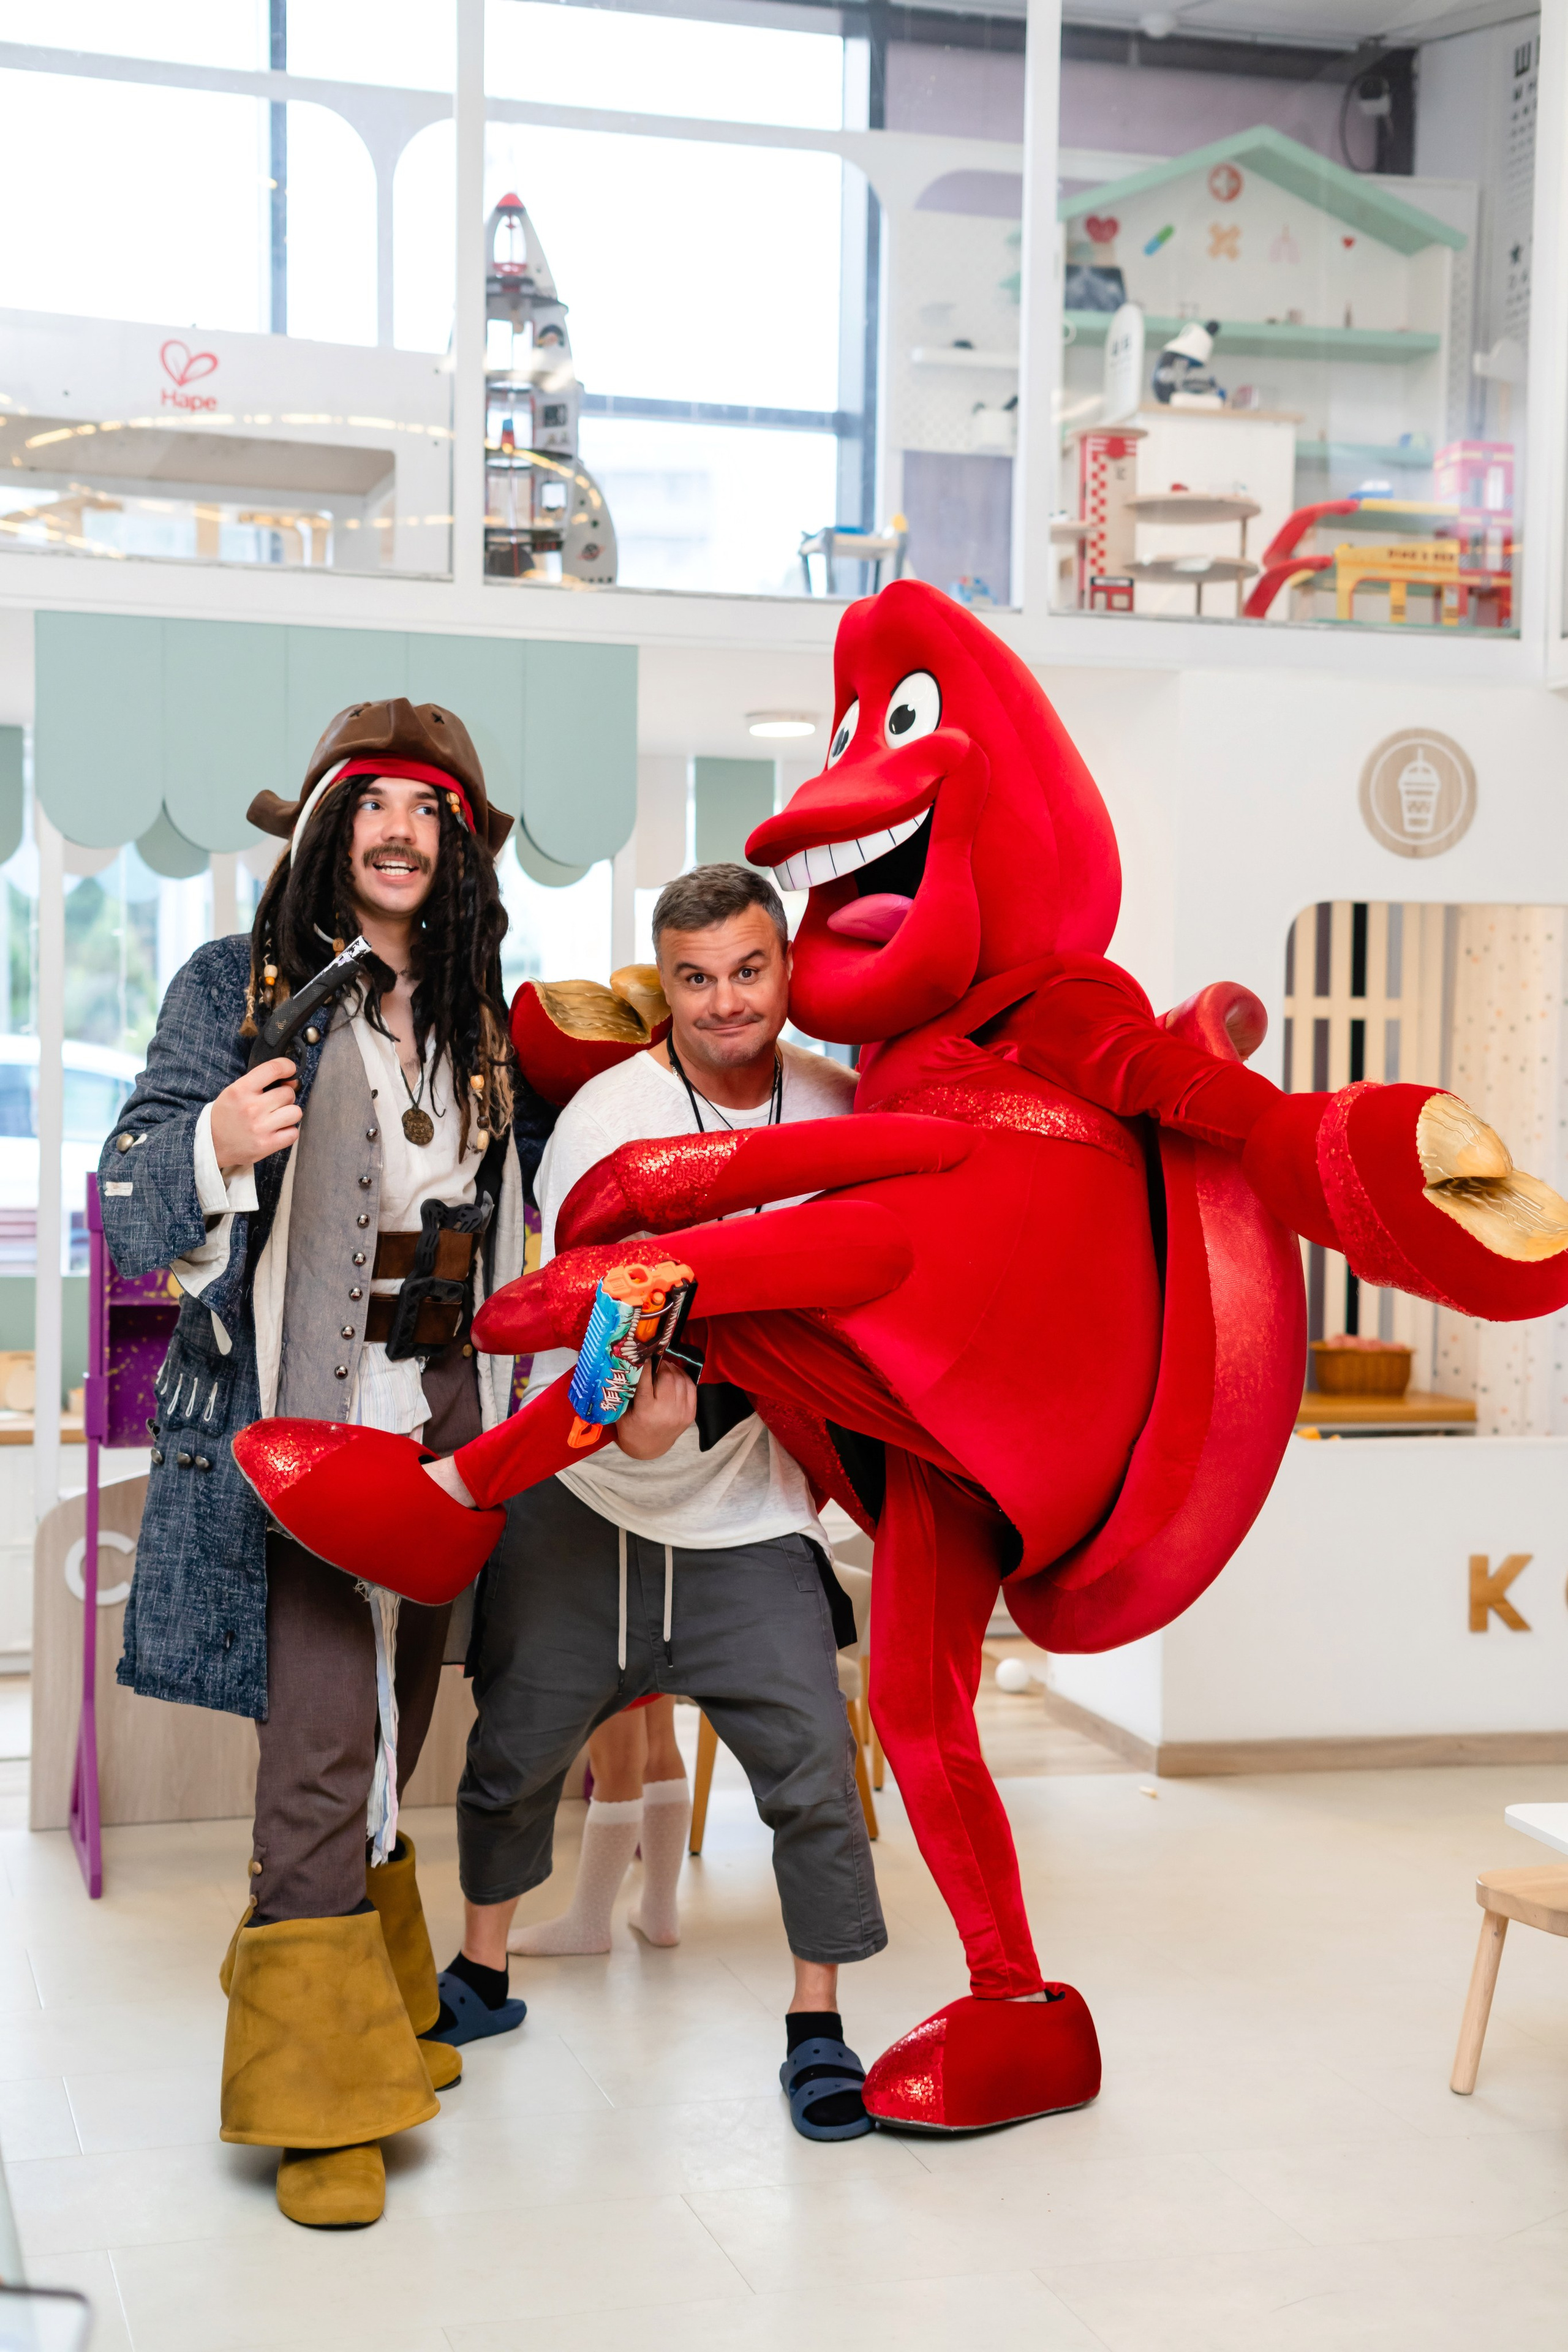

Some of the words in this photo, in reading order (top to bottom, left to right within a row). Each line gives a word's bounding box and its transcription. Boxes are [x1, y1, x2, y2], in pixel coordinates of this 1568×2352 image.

[161, 388, 217, 413] Hape
[605, 1368, 630, 1392] ME!
[600, 1387, 624, 1412] BITE
[1469, 1553, 1568, 1633] K
